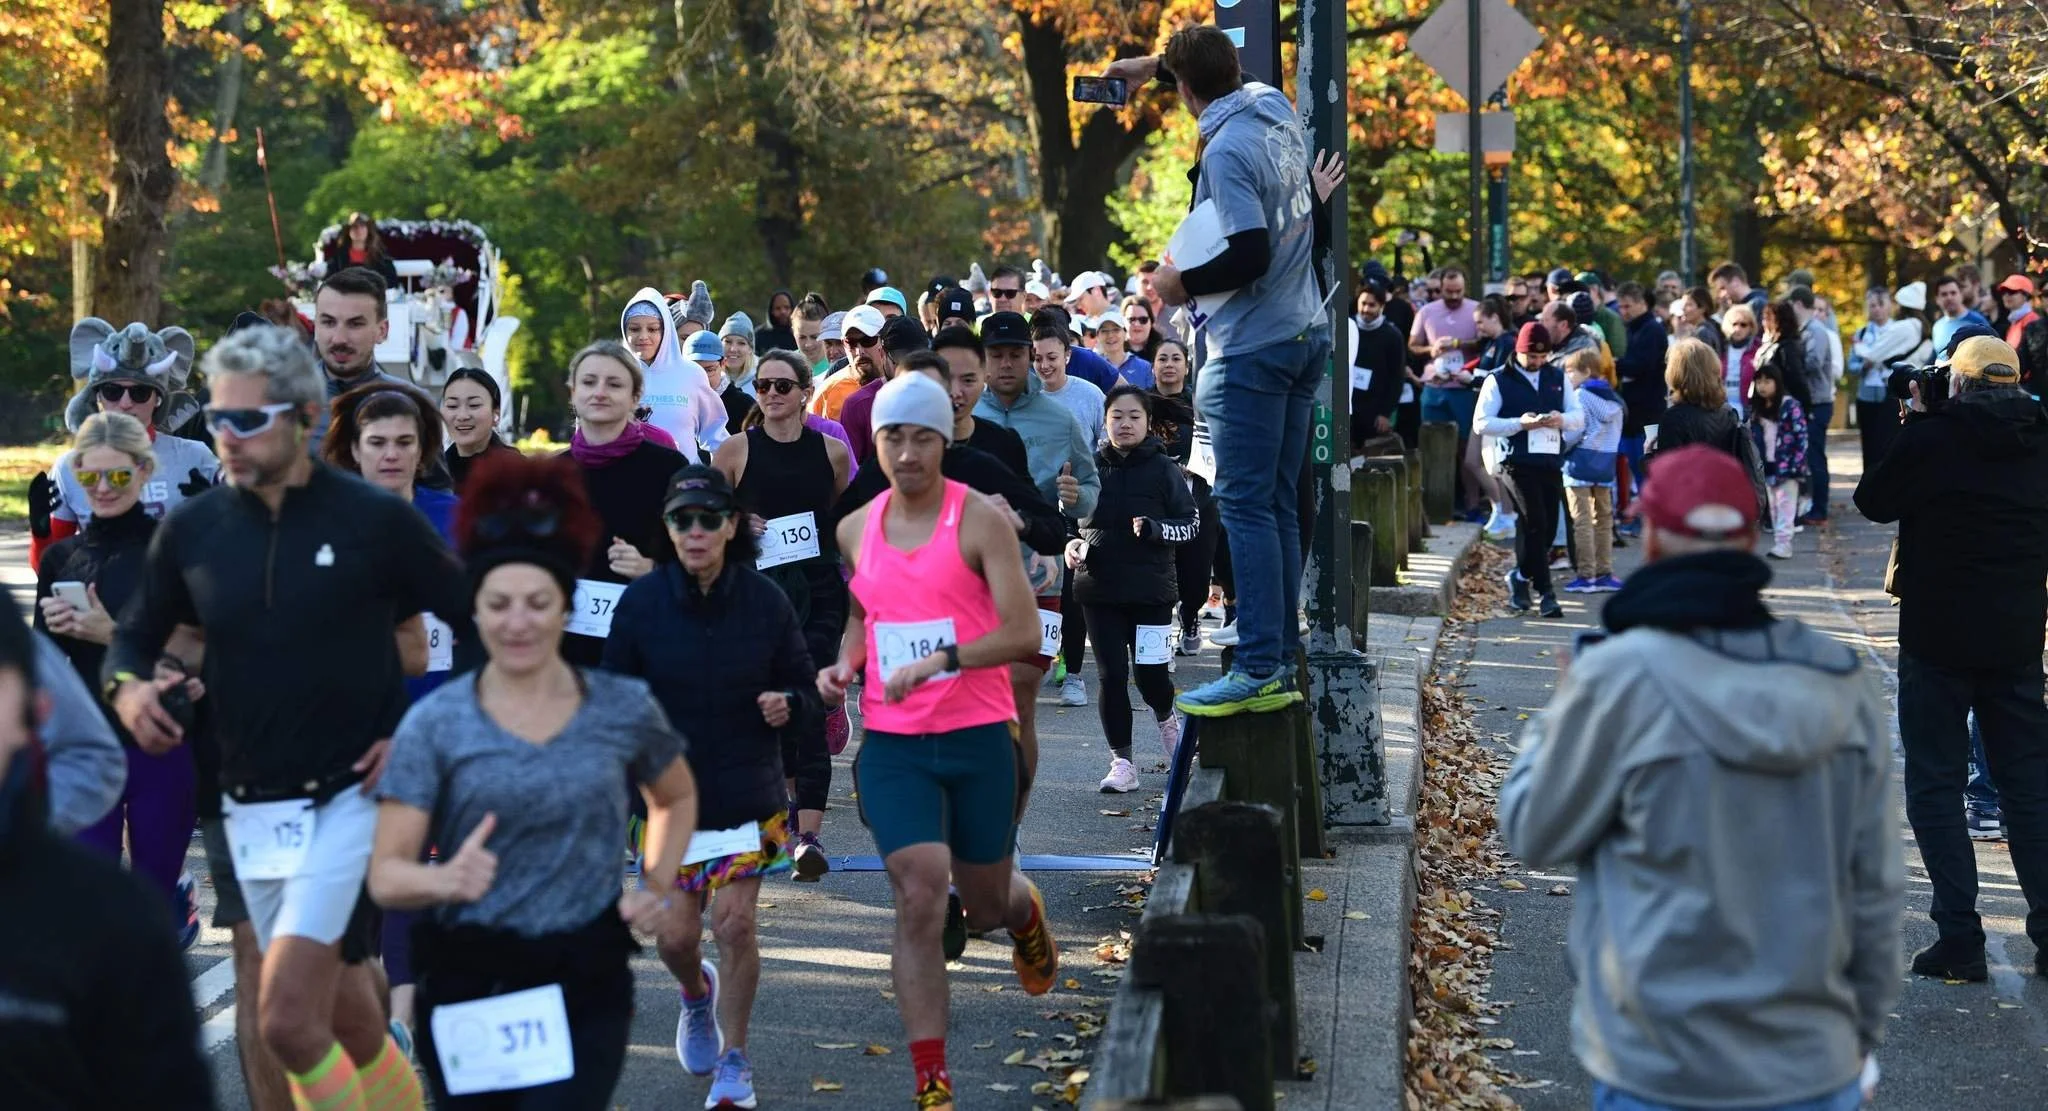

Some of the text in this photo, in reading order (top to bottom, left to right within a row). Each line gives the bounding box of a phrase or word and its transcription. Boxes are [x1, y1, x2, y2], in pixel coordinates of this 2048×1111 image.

[1315, 404, 1329, 461] 100
[781, 525, 811, 545] 130
[590, 597, 616, 617] 37
[1044, 623, 1060, 642] 18
[1258, 679, 1282, 697] HOKA
[273, 820, 303, 849] 175
[498, 1018, 548, 1055] 371
